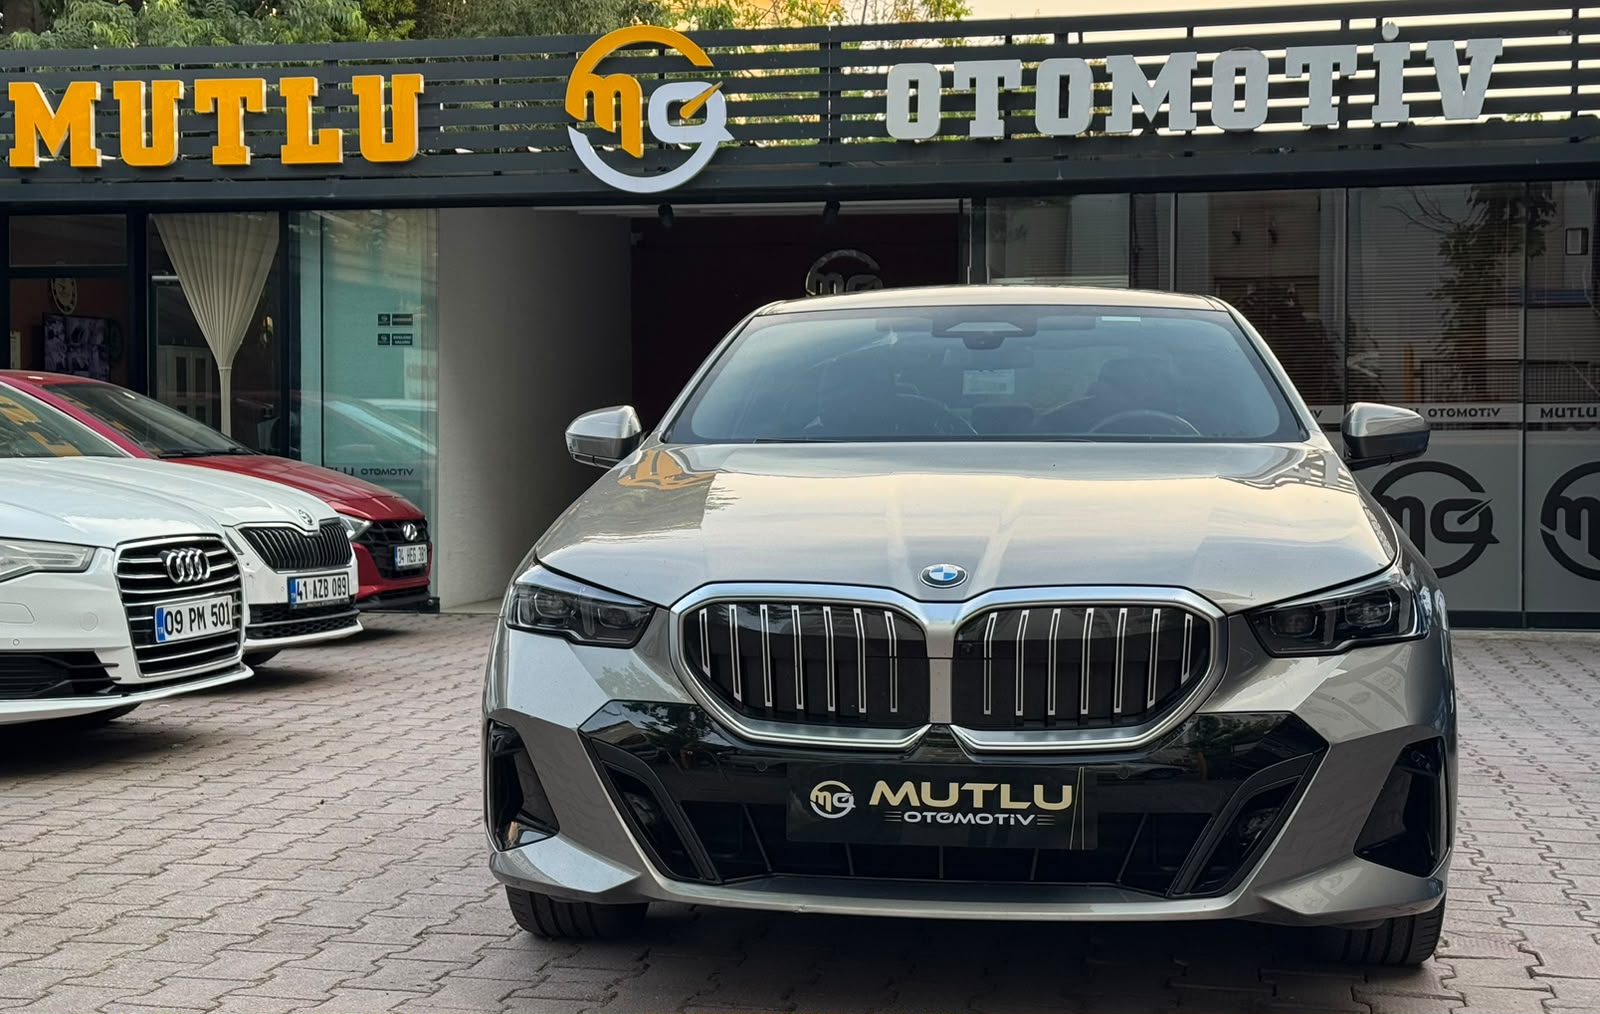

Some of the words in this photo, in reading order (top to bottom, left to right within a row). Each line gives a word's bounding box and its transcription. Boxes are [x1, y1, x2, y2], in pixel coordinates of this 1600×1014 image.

[886, 21, 1503, 139] OTOMOTİV
[8, 73, 424, 168] MUTLU
[1541, 407, 1598, 418] MUTLU
[297, 580, 308, 600] 41
[313, 579, 329, 599] AZB
[332, 576, 347, 597] 089
[164, 611, 183, 635] 09
[189, 606, 207, 632] PM
[211, 601, 231, 628] 501
[869, 780, 1073, 811] MUTLU
